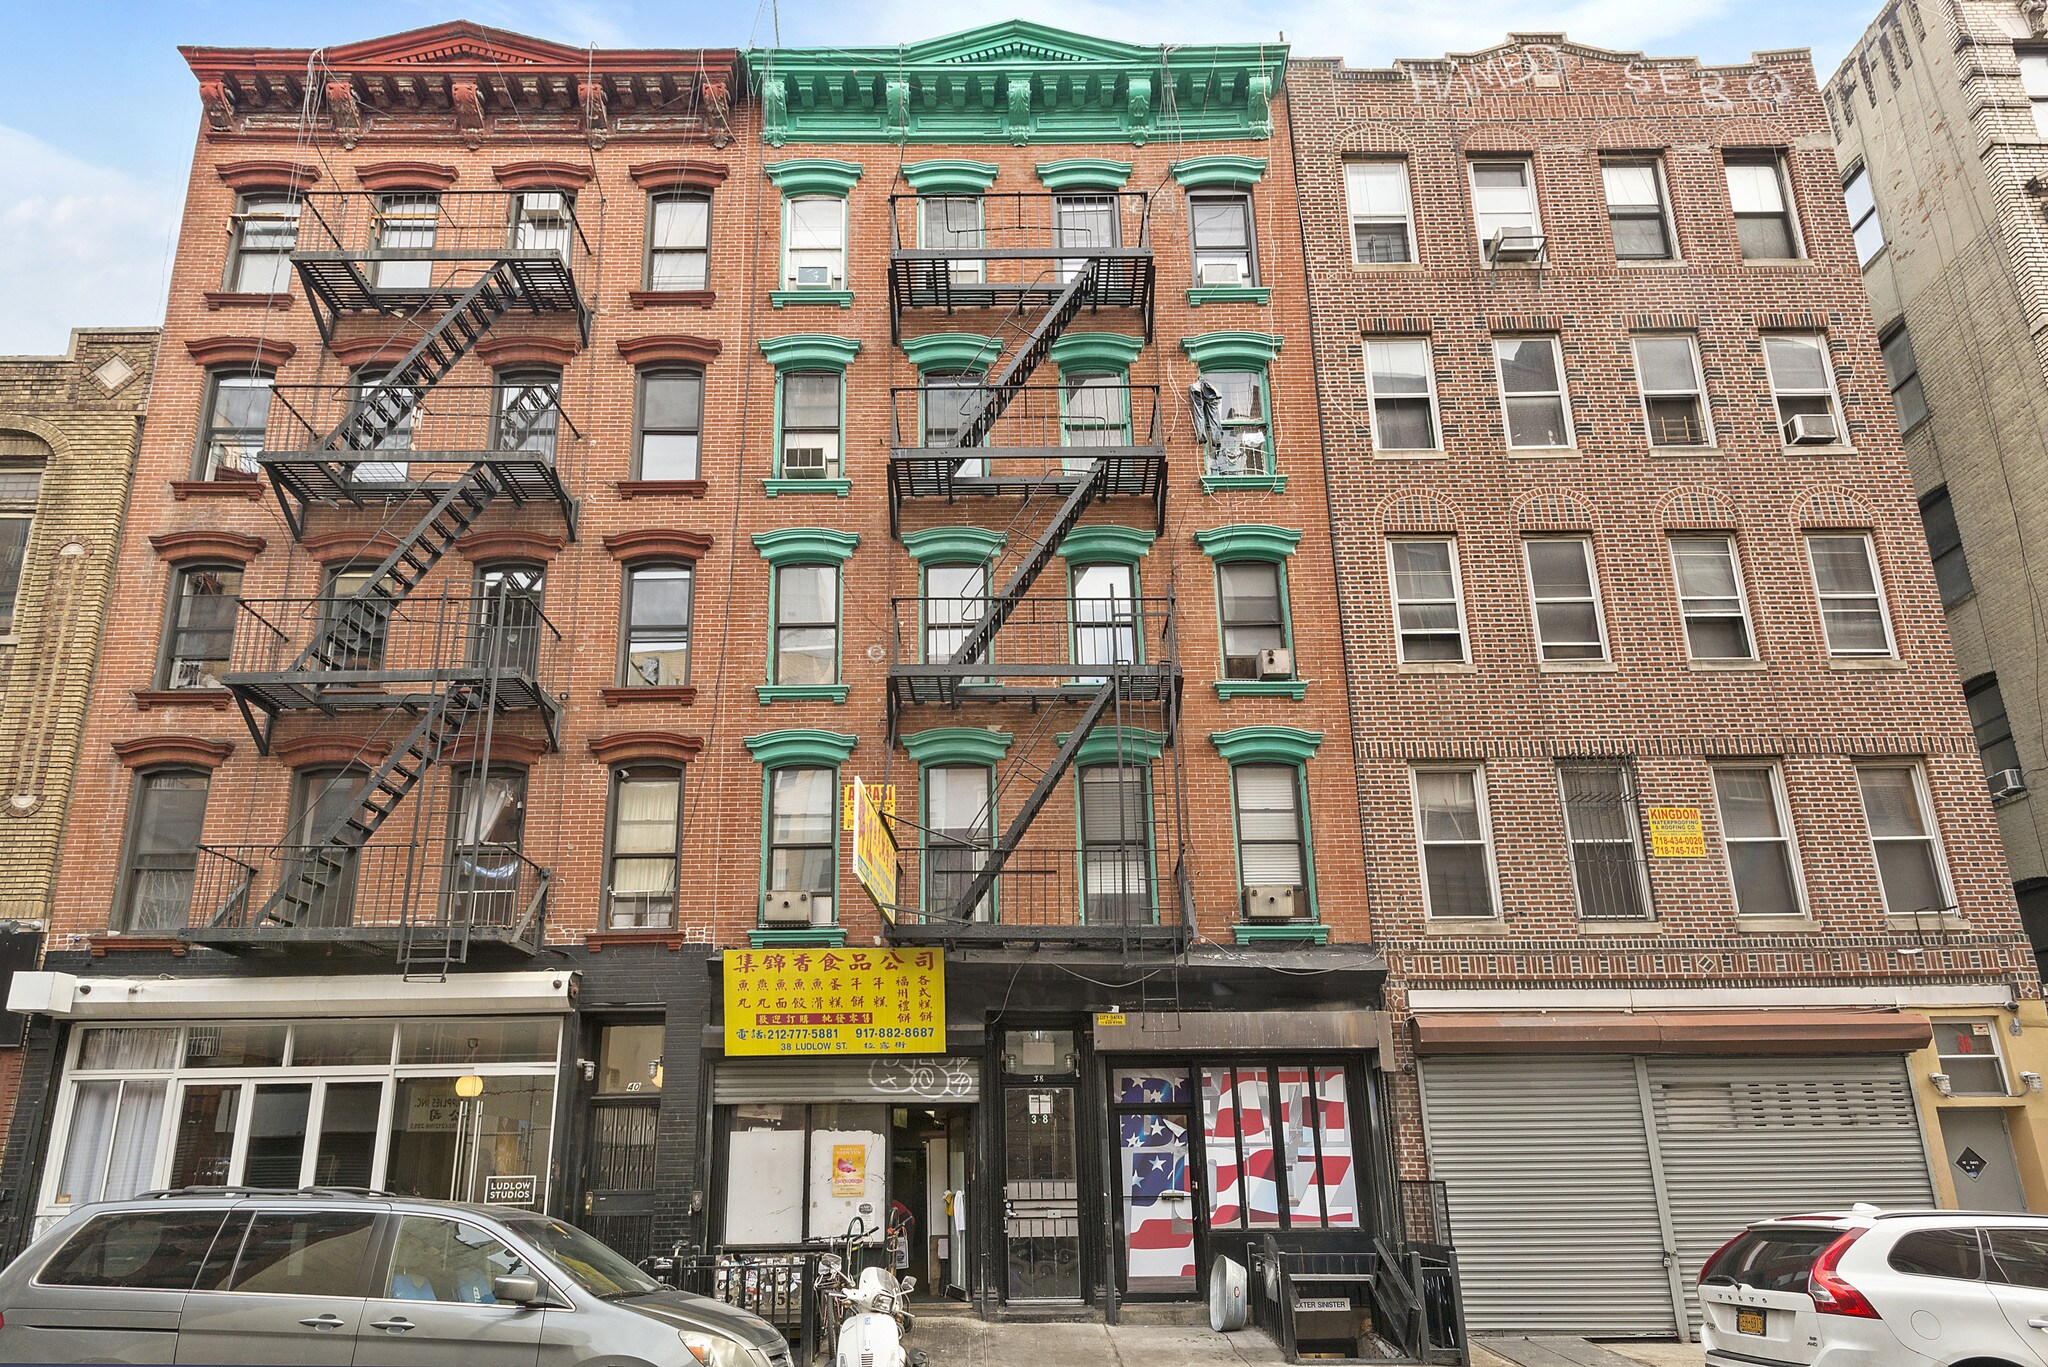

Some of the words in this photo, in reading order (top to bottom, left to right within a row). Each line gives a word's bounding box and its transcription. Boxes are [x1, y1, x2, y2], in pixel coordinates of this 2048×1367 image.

[1650, 809, 1699, 819] KINGDOM
[1654, 836, 1703, 845] 718-434-0020
[1655, 846, 1704, 855] 718-745-7475
[733, 949, 935, 974] 集錦香食品公司
[780, 1043, 792, 1051] 38
[795, 1042, 832, 1051] LUDLOW
[835, 1042, 848, 1050] ST.
[1957, 1034, 1973, 1053] 36
[1033, 1075, 1044, 1083] 38
[627, 1083, 640, 1092] 40
[491, 1182, 531, 1190] LUDLOW
[490, 1190, 530, 1199] STUDIOS
[1717, 1293, 1768, 1304] VOLVO
